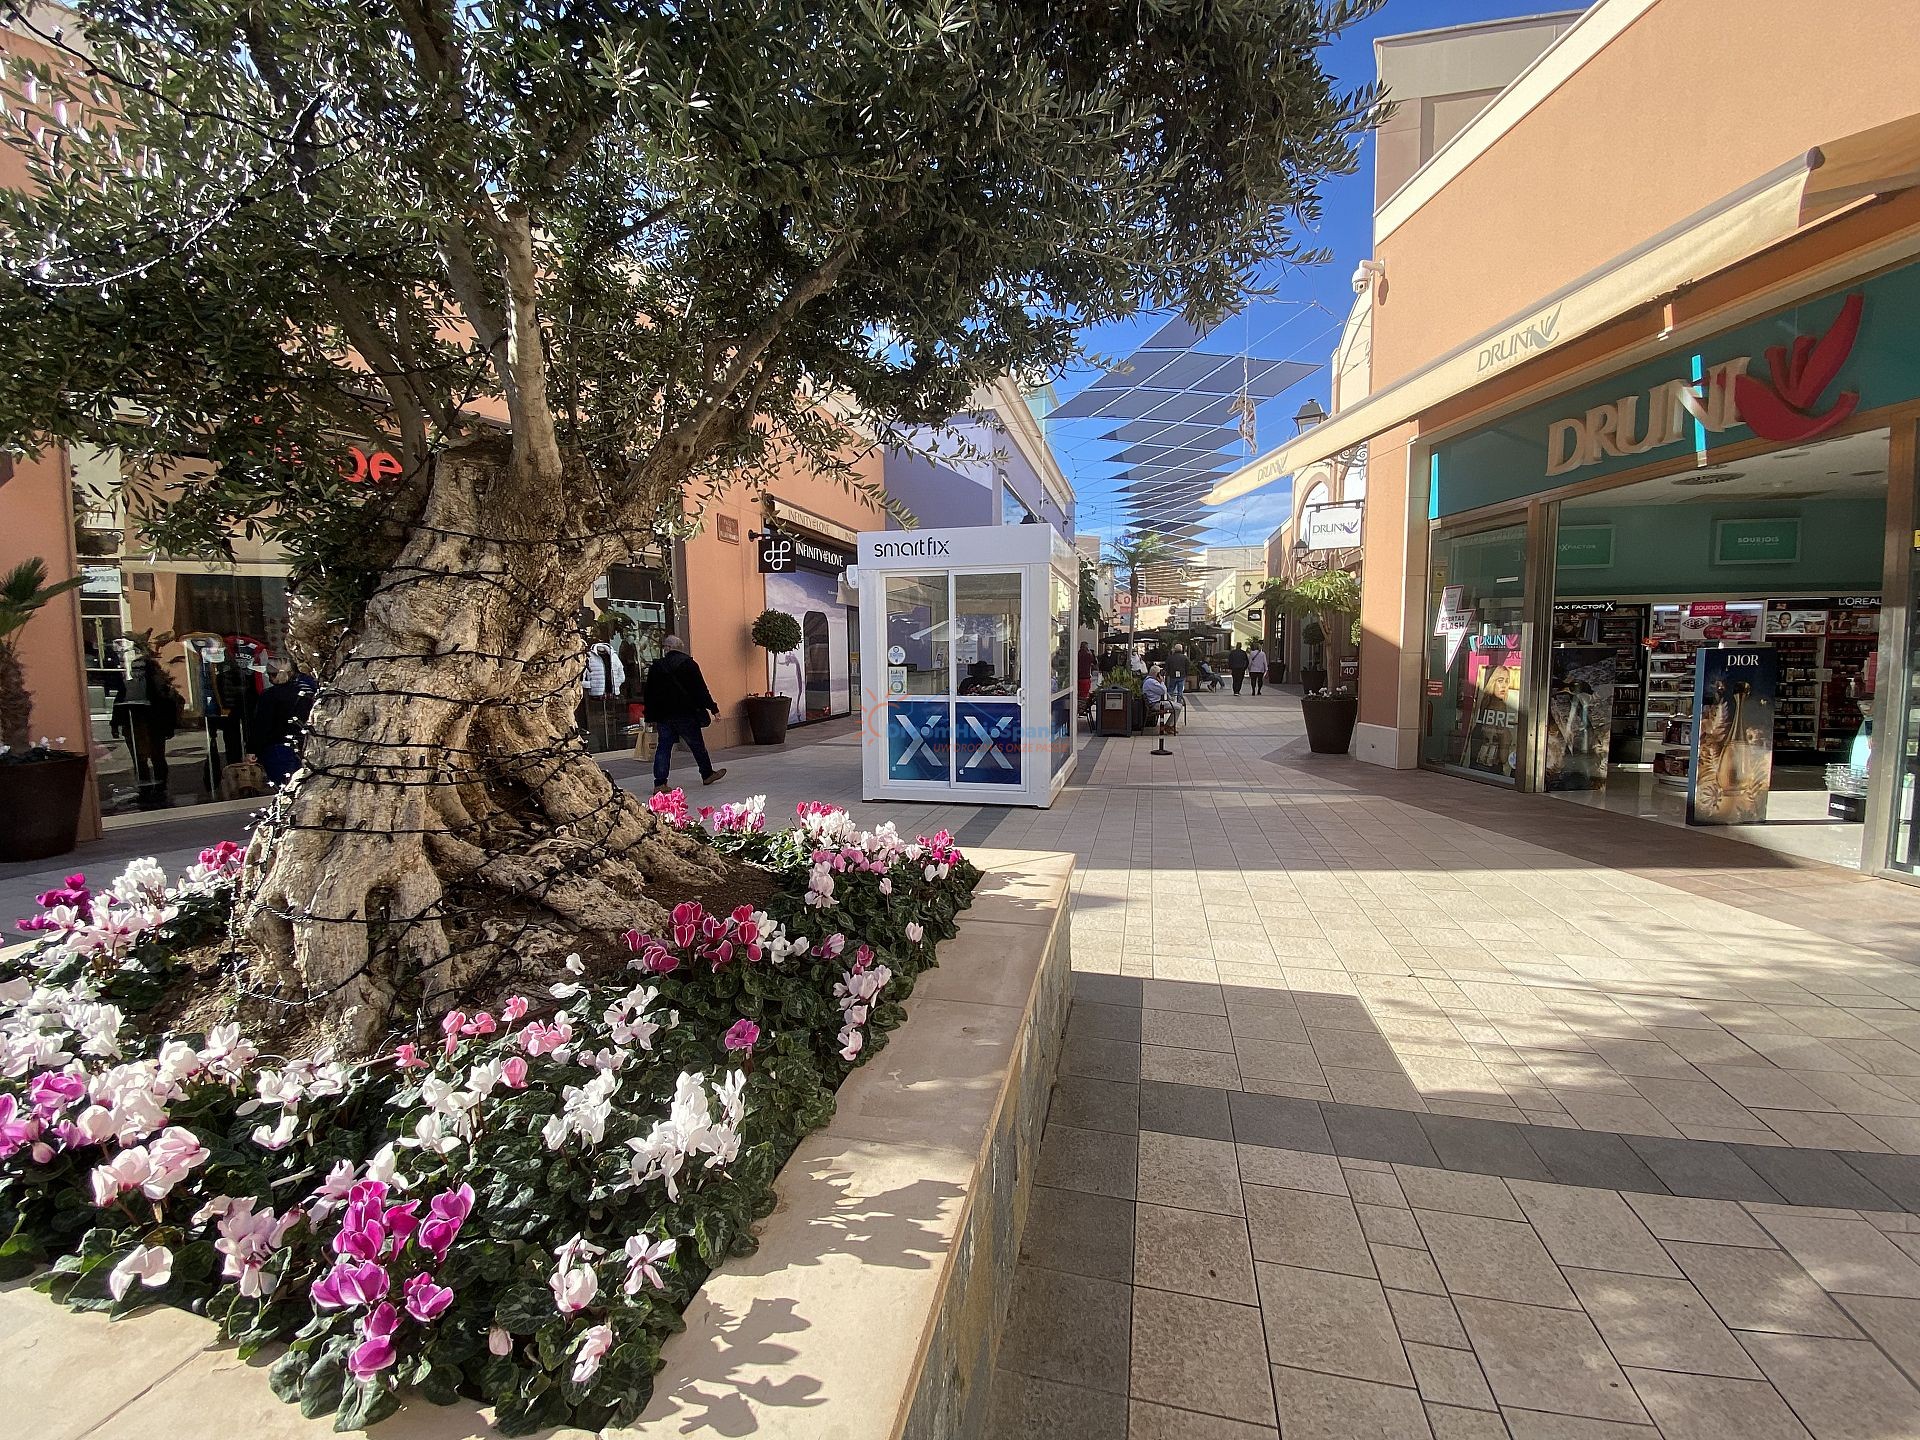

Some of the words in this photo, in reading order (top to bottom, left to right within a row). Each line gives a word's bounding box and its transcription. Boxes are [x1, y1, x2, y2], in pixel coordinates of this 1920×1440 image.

[1546, 356, 1750, 478] DRUNI
[795, 542, 822, 562] INFINITY
[828, 552, 843, 567] LOVE
[873, 537, 950, 557] smartfix
[1440, 622, 1465, 630] FLASH
[1726, 654, 1759, 666] DIOR
[1475, 708, 1516, 729] LIBRE
